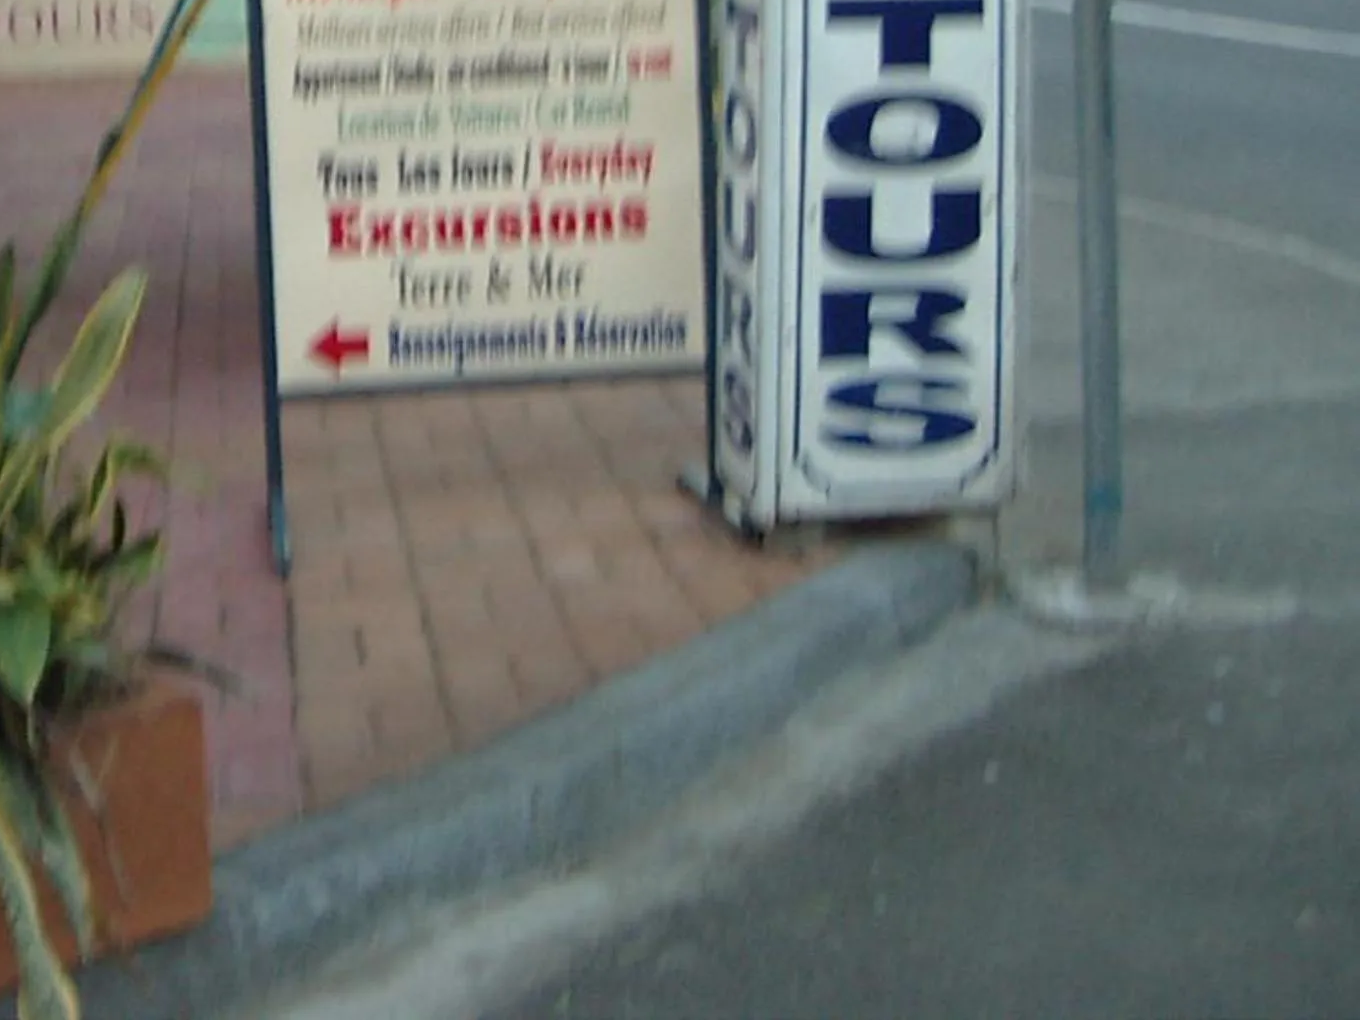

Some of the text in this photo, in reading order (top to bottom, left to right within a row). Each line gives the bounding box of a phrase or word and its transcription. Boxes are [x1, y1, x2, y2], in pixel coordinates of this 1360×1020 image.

[318, 147, 379, 198] Tous
[327, 190, 648, 261] Excursions
[391, 257, 472, 309] Terre
[527, 250, 586, 300] Mer
